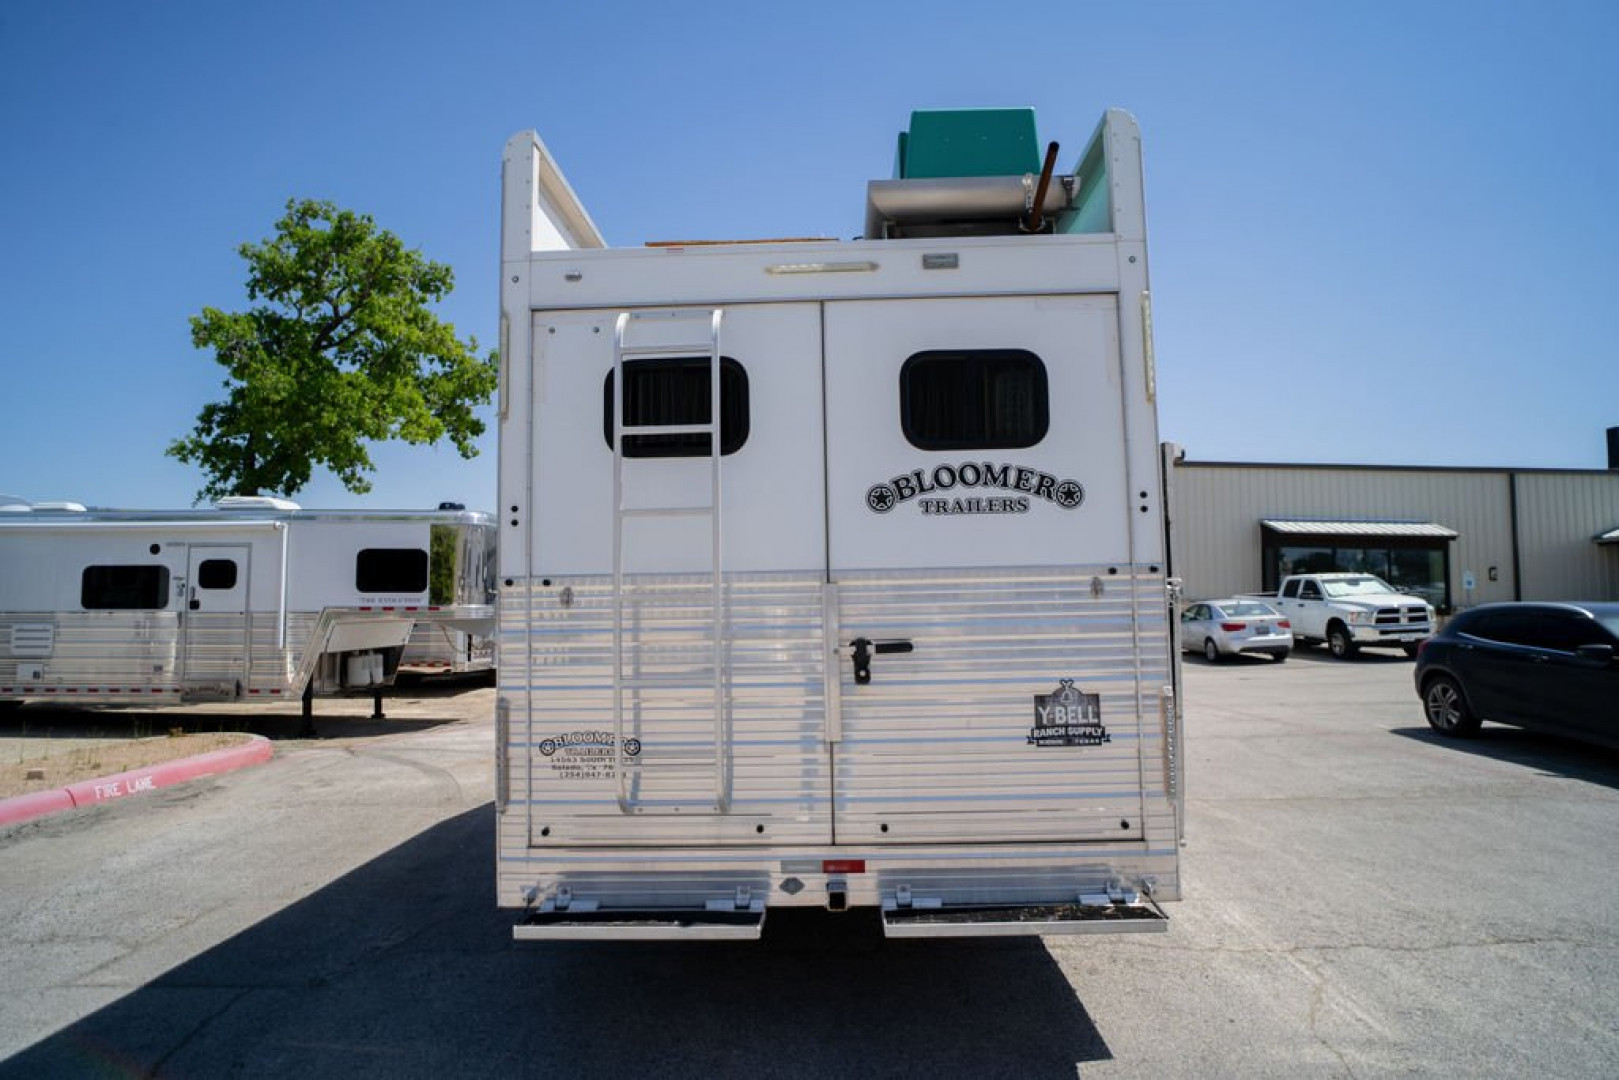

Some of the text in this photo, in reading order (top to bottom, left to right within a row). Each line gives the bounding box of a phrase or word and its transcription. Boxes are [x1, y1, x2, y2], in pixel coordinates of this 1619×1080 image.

[890, 461, 1057, 502] BLOOMER
[920, 498, 1029, 514] TRAILERS
[1037, 706, 1098, 725] Y-BELL
[1034, 726, 1103, 737] RANCH SUPPLY
